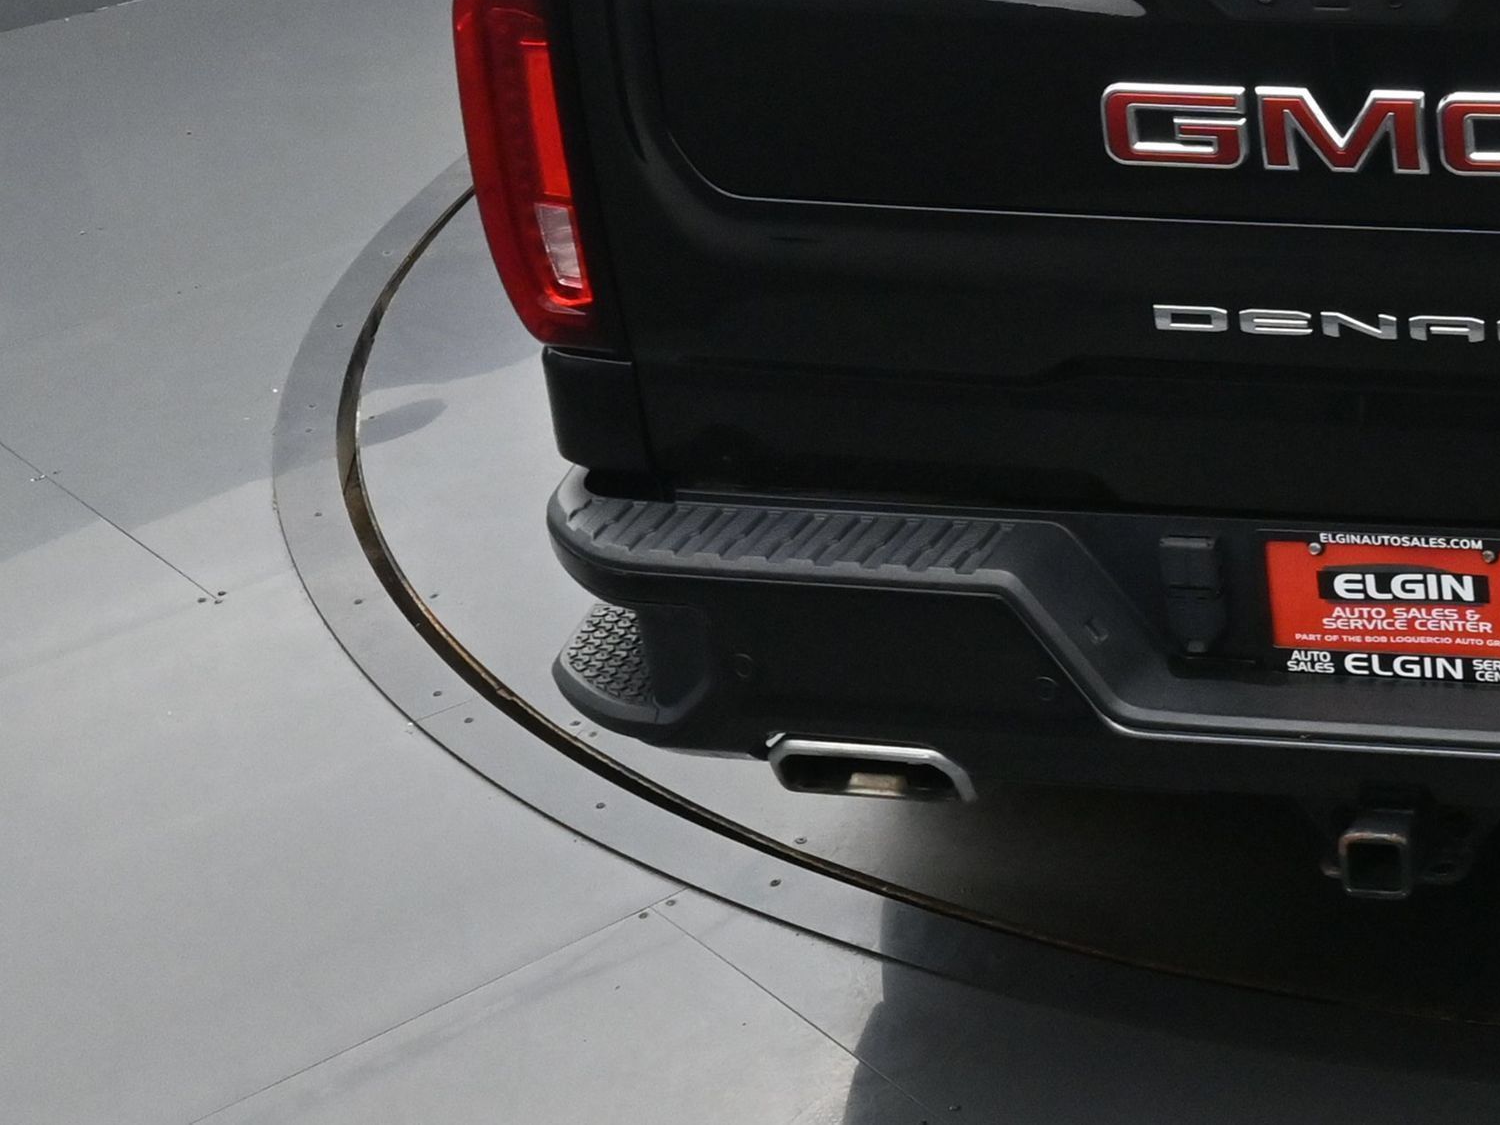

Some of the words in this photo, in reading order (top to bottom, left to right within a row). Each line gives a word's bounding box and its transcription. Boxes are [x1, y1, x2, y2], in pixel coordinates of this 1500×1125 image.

[1319, 533, 1483, 550] ELGINAUTOSALES.COM
[1333, 573, 1475, 602] ELGIN
[1332, 607, 1386, 619] AUTO
[1392, 607, 1458, 620] SALES
[1465, 610, 1480, 621] &
[1322, 618, 1408, 631] SERVICE
[1414, 620, 1493, 634] CENTER
[1295, 633, 1322, 641] PART
[1342, 635, 1362, 643] THE
[1365, 635, 1387, 643] BOB
[1390, 636, 1451, 645] LOQUERCIO
[1455, 638, 1484, 646] AUTO
[1290, 650, 1331, 662] AUTO
[1286, 660, 1335, 673] SALES
[1344, 653, 1463, 680] ELGIN
